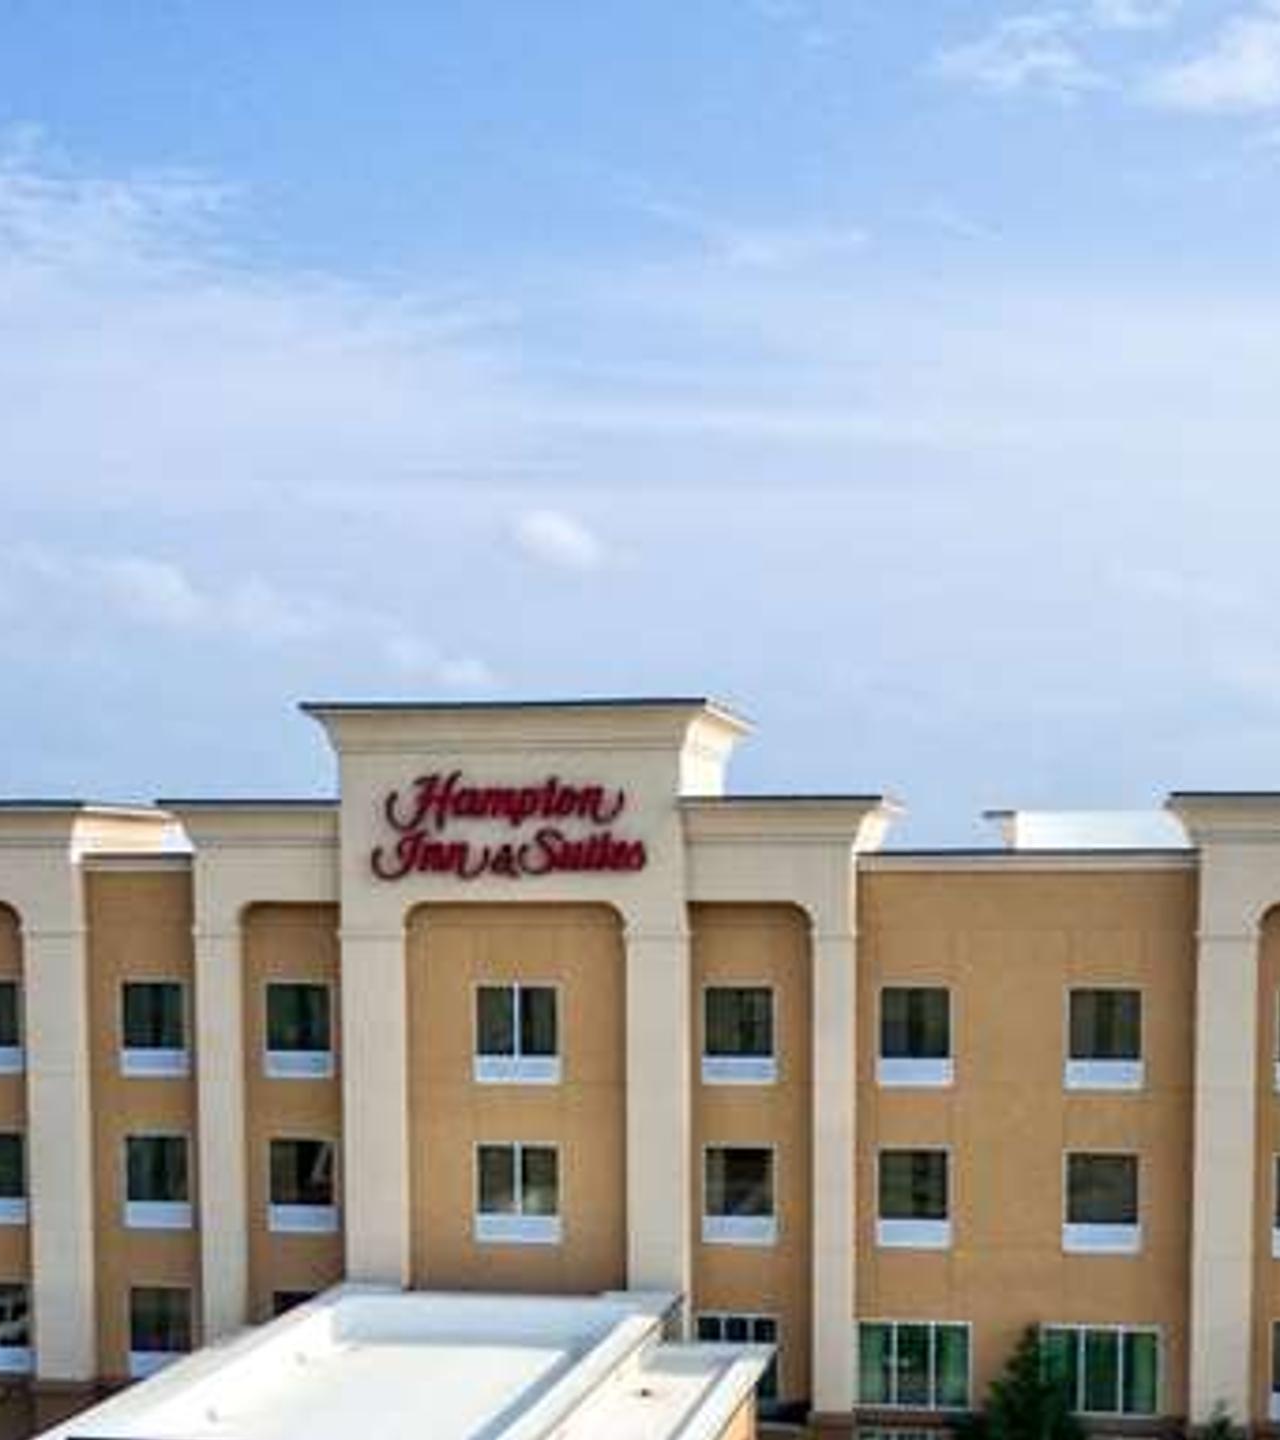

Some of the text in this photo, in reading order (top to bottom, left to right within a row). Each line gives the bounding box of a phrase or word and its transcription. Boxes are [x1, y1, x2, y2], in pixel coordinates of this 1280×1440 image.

[386, 770, 624, 830] Hampton
[371, 828, 647, 880] Inn & Suites
